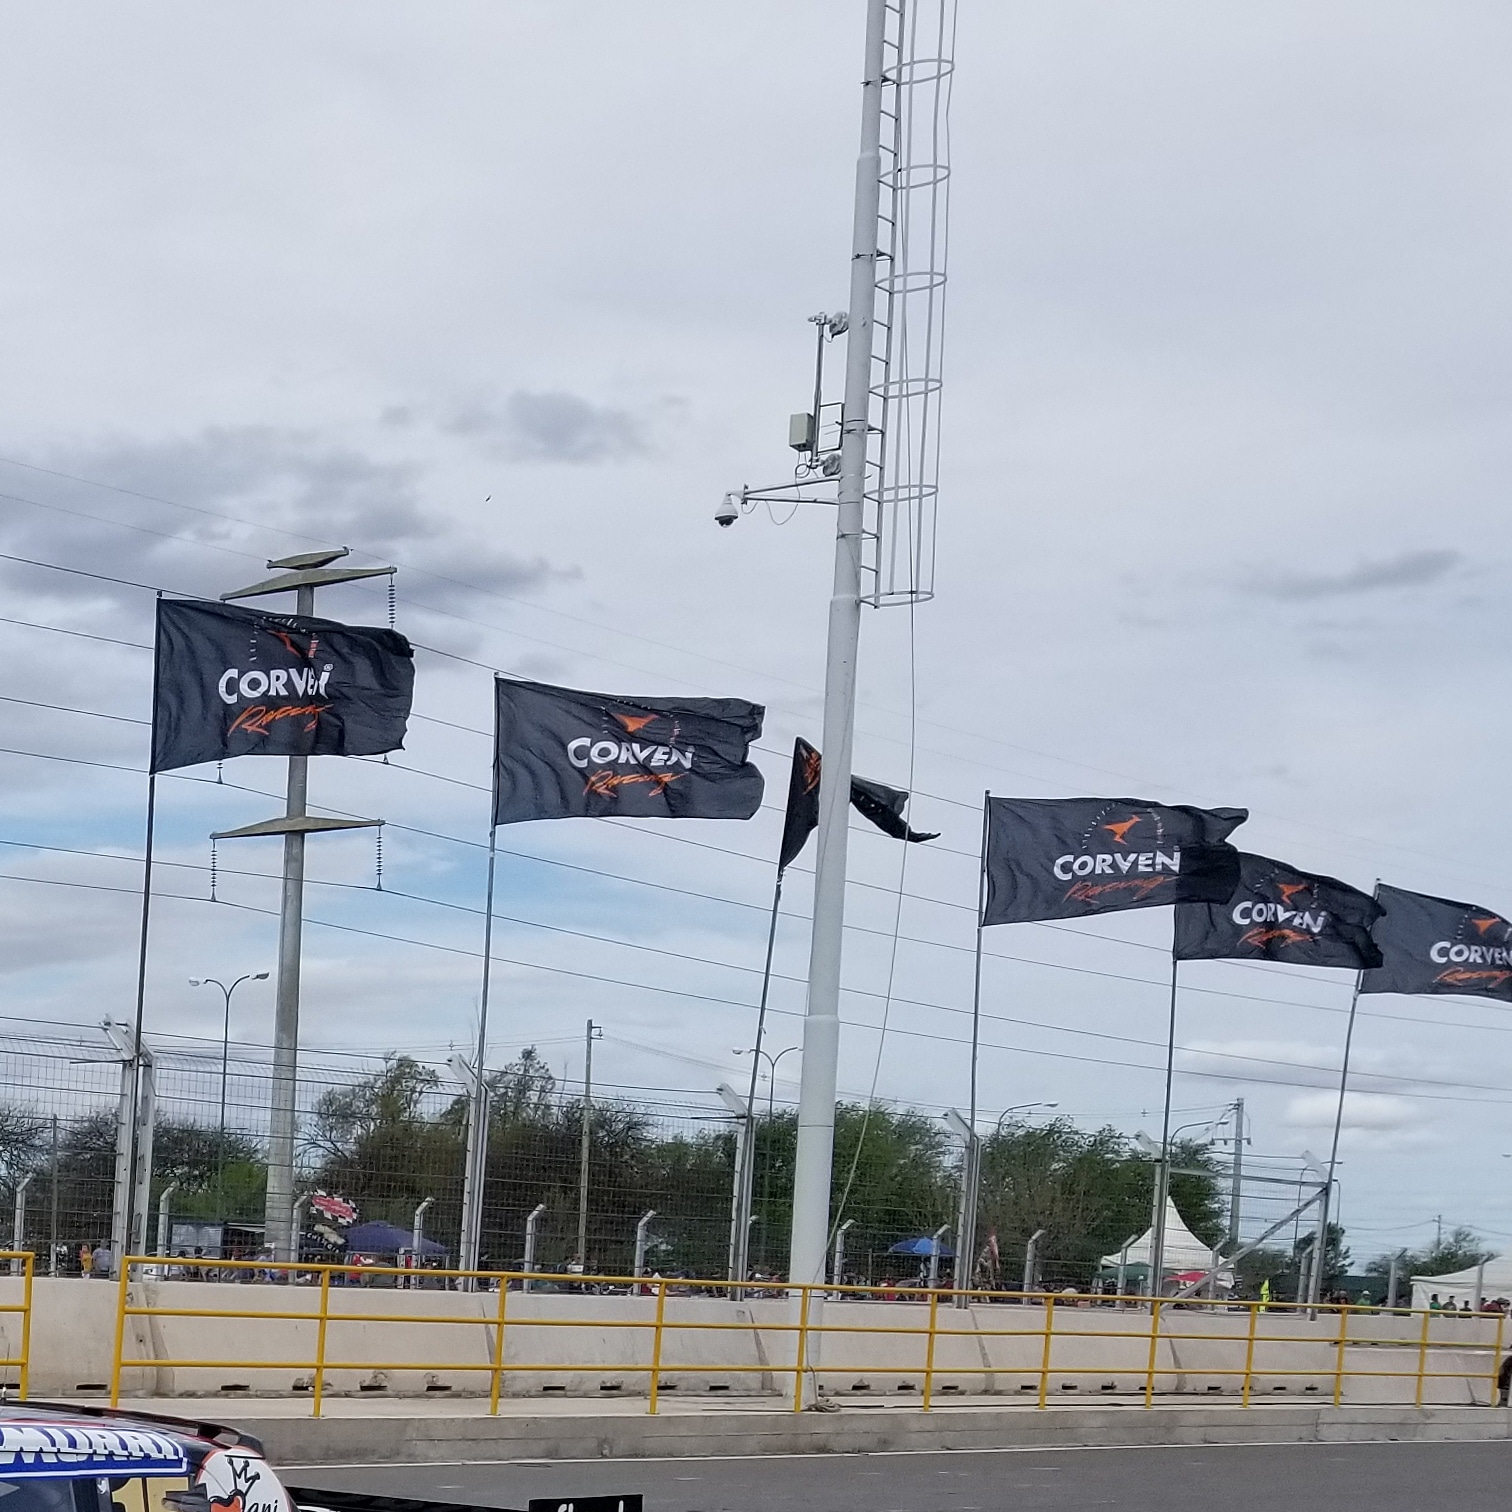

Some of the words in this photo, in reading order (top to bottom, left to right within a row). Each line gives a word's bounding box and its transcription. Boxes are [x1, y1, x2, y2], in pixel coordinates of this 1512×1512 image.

[218, 667, 331, 705] CORVEN
[567, 737, 693, 769] CORVEN
[1053, 850, 1181, 880] CORVEN
